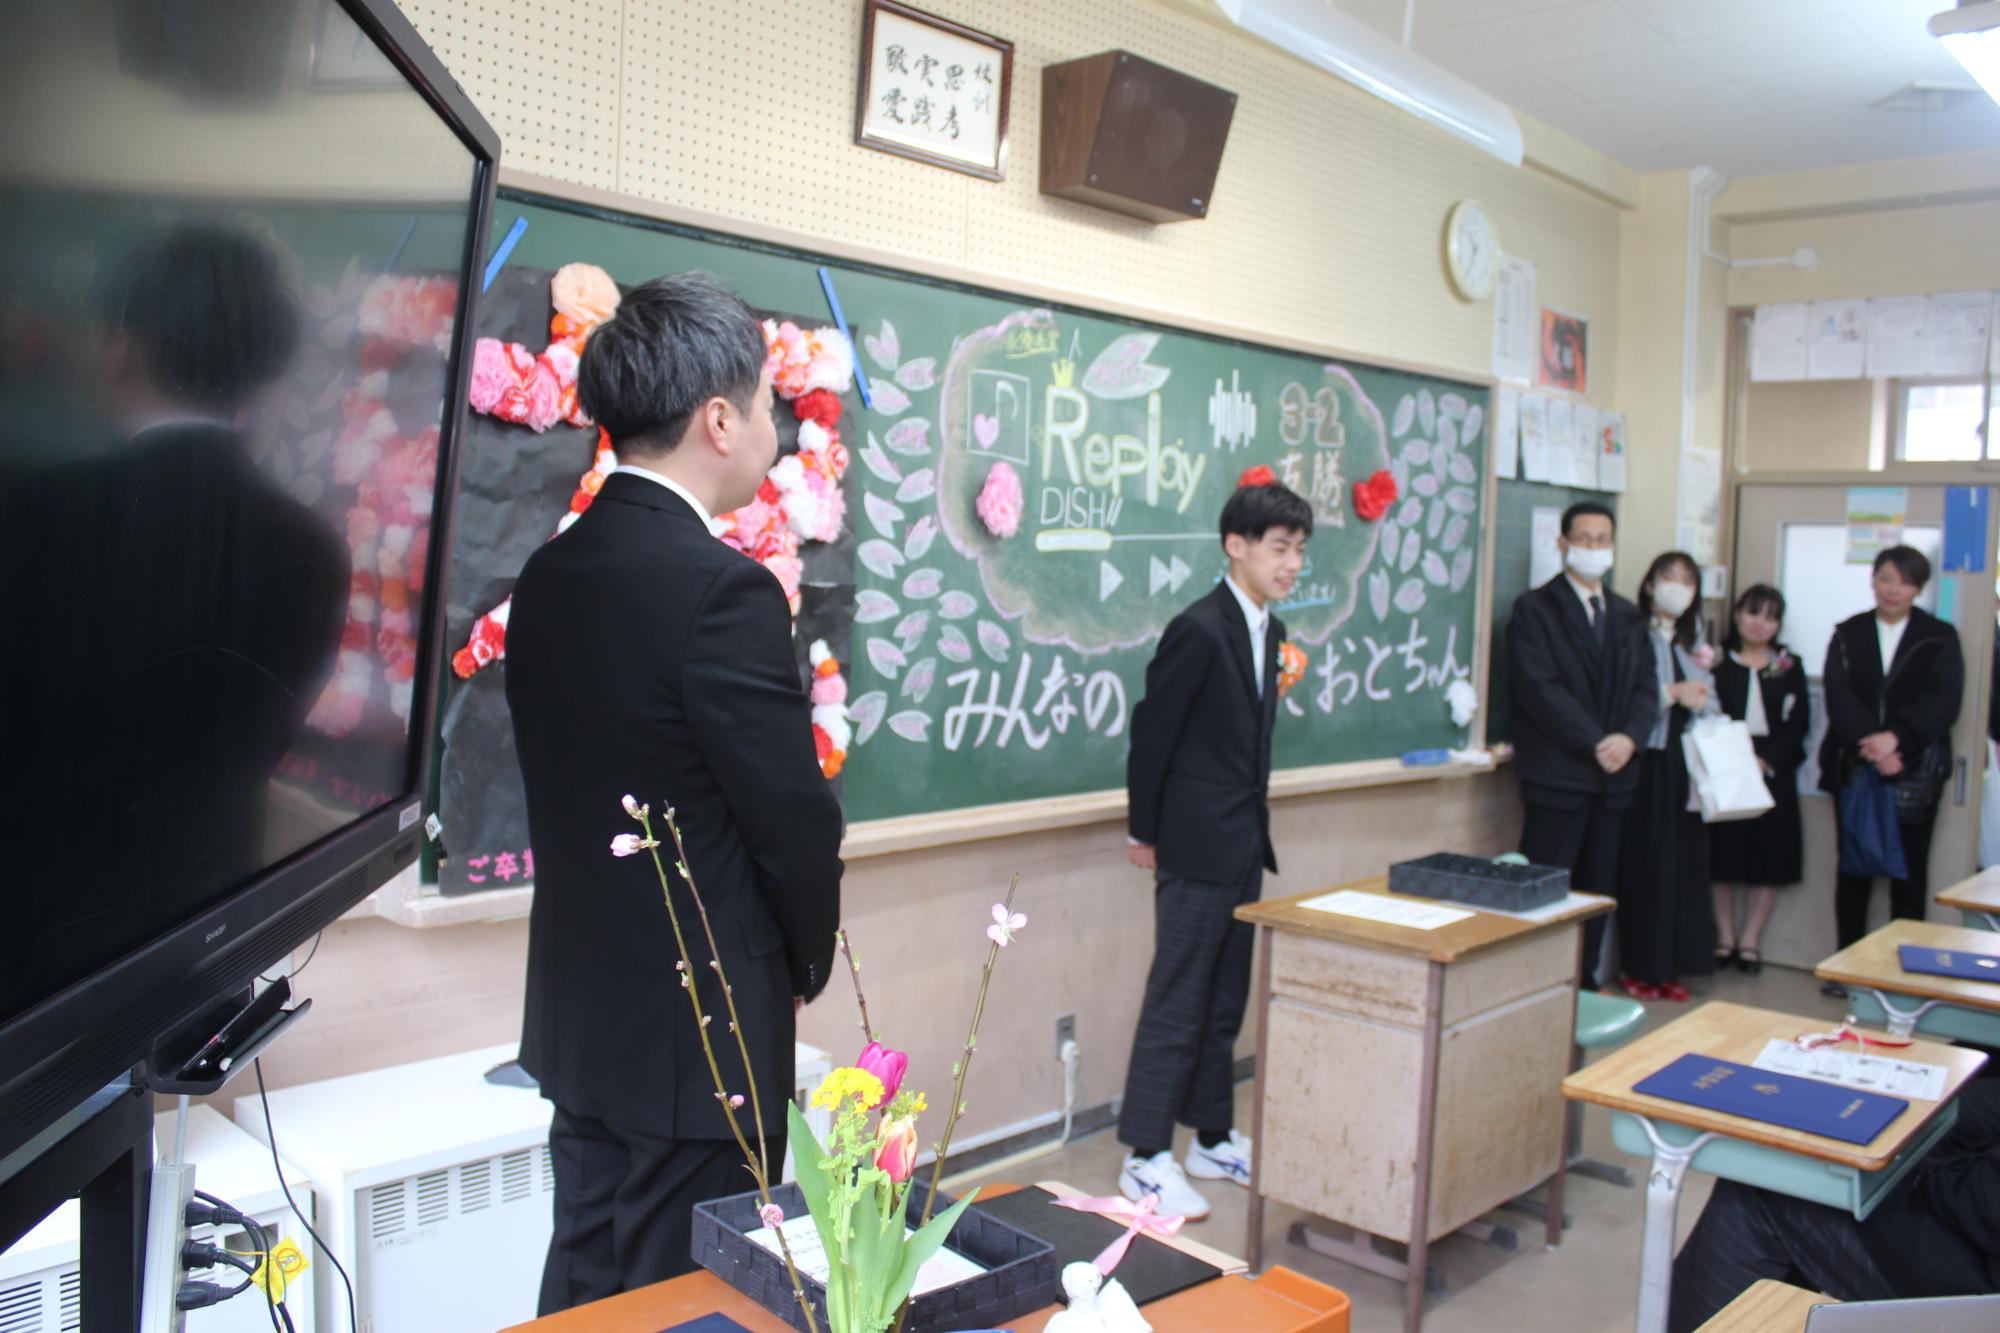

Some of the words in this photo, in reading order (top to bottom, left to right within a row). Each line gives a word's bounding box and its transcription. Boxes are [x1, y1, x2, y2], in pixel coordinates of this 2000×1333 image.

[1041, 384, 1207, 514] Replay
[1279, 382, 1345, 448] 3-2
[943, 651, 1127, 751] みんなの
